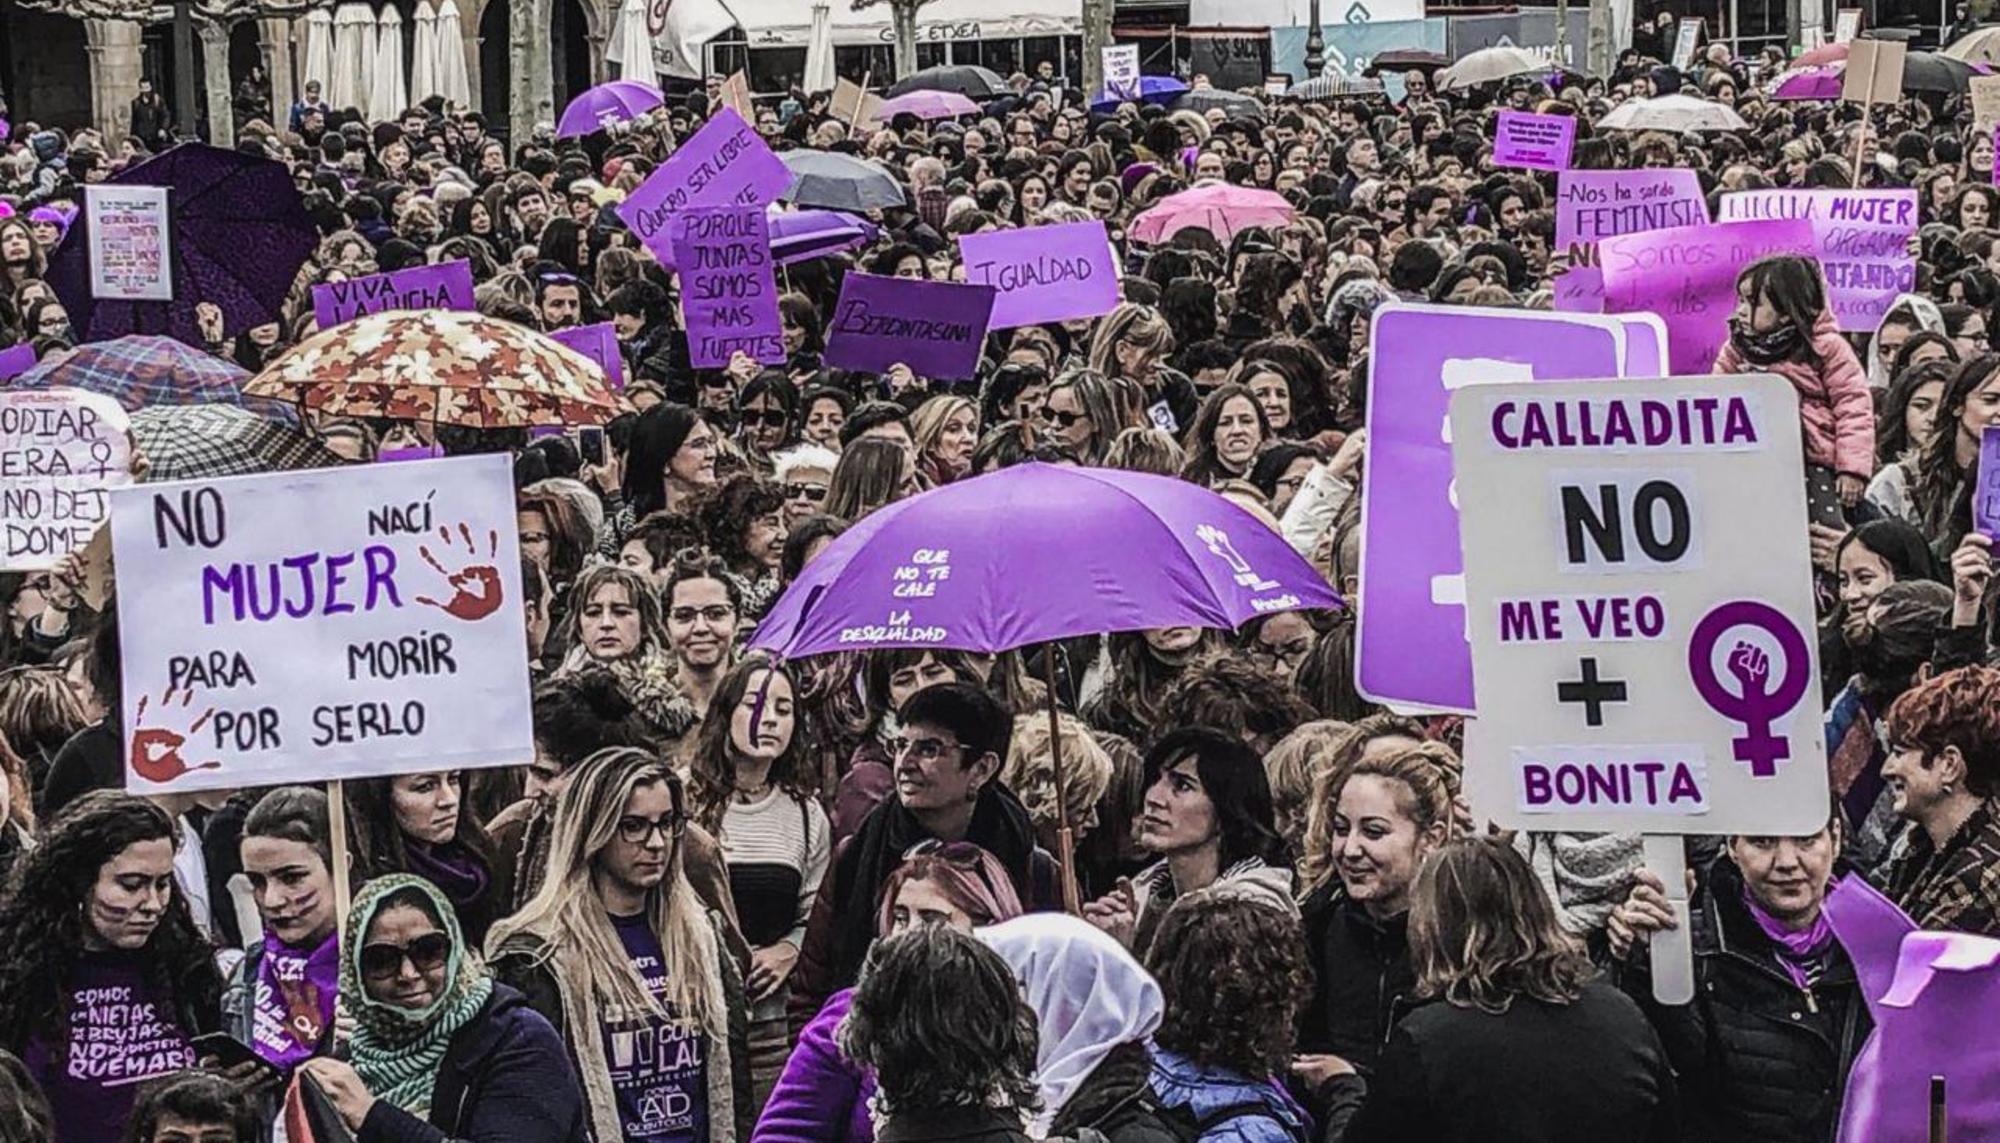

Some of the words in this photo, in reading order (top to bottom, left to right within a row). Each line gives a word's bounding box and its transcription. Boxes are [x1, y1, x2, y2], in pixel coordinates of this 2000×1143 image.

[929, 23, 982, 40] ETXEA
[687, 161, 717, 195] SER
[713, 128, 753, 172] LIBRE
[1614, 181, 1631, 200] ha
[682, 211, 761, 240] PORQUE
[1576, 199, 1706, 237] FEMINISTA
[1829, 197, 1914, 226] MUJER
[692, 243, 764, 271] JUNTAS
[1612, 237, 1717, 271] Somos
[693, 273, 761, 299] SOMOS
[975, 256, 1091, 292] IGUALDAD
[331, 278, 395, 304] VIVA
[712, 305, 753, 327] MAS
[1492, 397, 1757, 449] CALLADITA
[4, 489, 42, 519] NO
[154, 486, 225, 549] NO
[368, 489, 436, 536] NACÍ
[1560, 480, 1691, 564] NO
[912, 549, 950, 565] QUE
[203, 545, 404, 625] MUJER
[893, 566, 919, 581] NO
[926, 565, 951, 581] TE
[892, 581, 936, 598] CALE
[888, 609, 912, 626] LA
[1501, 600, 1563, 641] ME
[1576, 595, 1665, 638] VEO
[169, 650, 256, 691] PARA
[214, 707, 281, 751] POR
[312, 699, 426, 747] SERLO
[1523, 762, 1702, 805] BONITA
[74, 986, 131, 1007] SOMOS
[88, 1003, 156, 1026] NIETAS
[88, 1022, 163, 1044] BRUJAS
[68, 1050, 184, 1081] QUEMAR
[69, 1042, 106, 1061] NO
